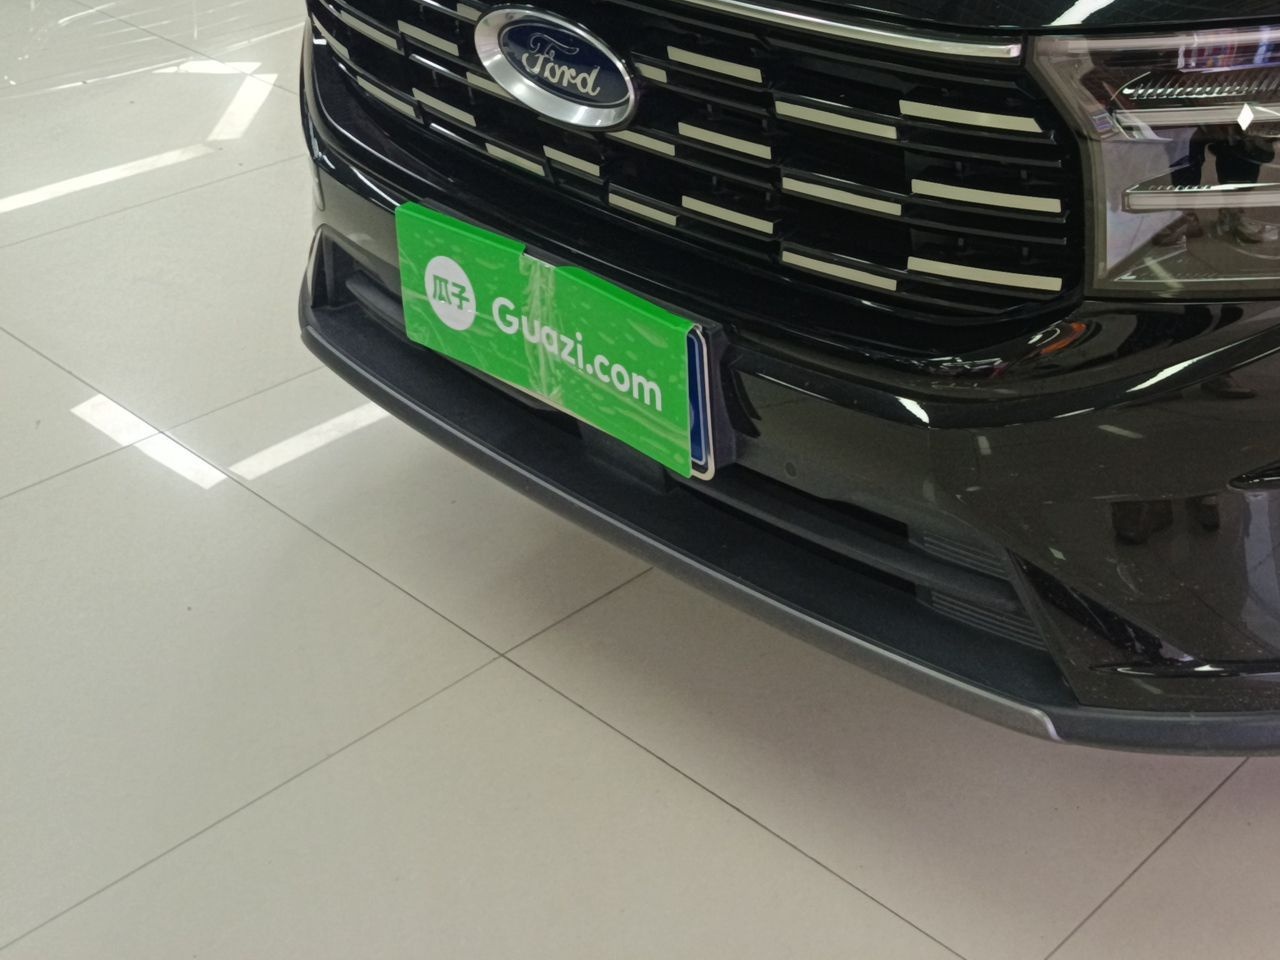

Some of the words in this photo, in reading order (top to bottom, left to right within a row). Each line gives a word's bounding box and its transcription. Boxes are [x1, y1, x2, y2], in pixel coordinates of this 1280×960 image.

[521, 32, 601, 96] Ford
[432, 274, 470, 311] 瓜子
[491, 296, 663, 412] Guazi.com
